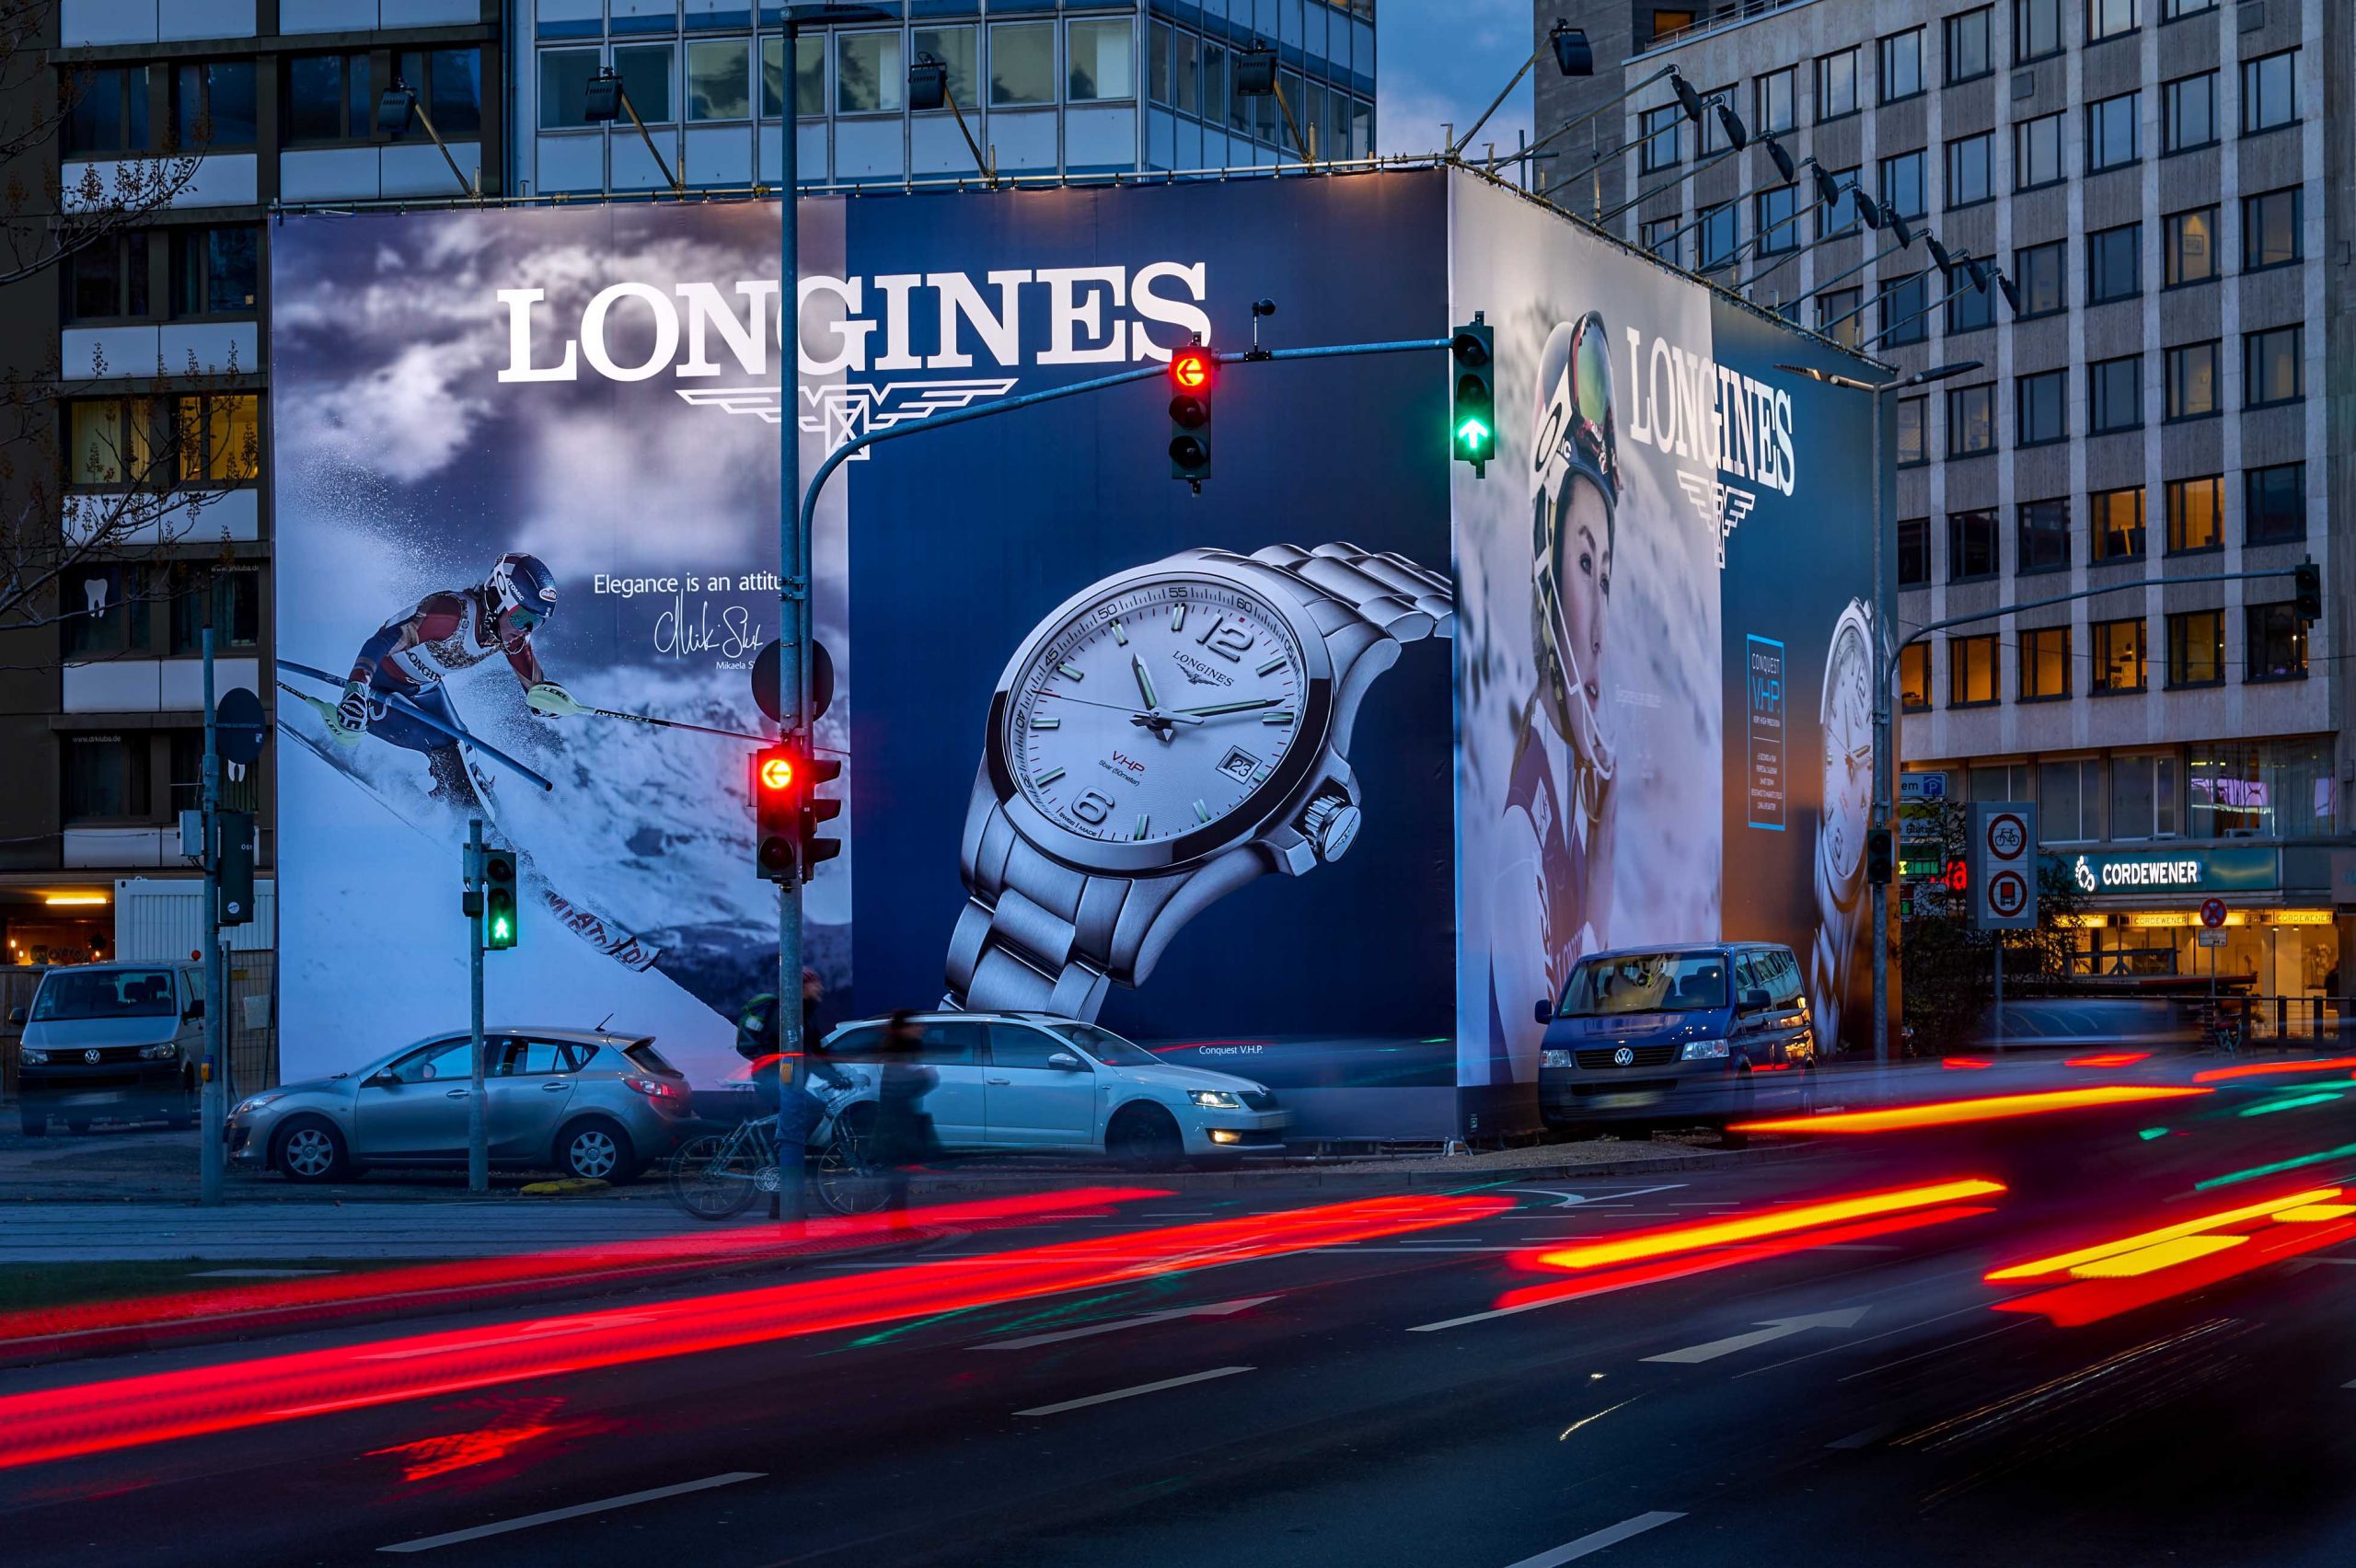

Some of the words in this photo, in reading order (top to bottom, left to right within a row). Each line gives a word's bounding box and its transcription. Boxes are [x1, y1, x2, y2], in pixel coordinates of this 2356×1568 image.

[497, 262, 1211, 383] LONGINES
[1627, 327, 1794, 496] LONGINES
[506, 577, 525, 602] ATOMIC
[595, 574, 678, 598] Elegance
[687, 572, 699, 592] is
[708, 576, 731, 592] an
[739, 571, 781, 591] attitu
[1169, 587, 1188, 598] 55
[1097, 604, 1118, 619] 50
[1236, 599, 1253, 613] 60
[1195, 613, 1254, 663] 12
[716, 661, 745, 670] Mikaela
[1045, 650, 1058, 667] 45
[1172, 651, 1235, 686] LONGINES
[1752, 652, 1781, 675] CONQUEST
[1015, 709, 1026, 729] 40
[1230, 757, 1253, 778] 23
[1900, 782, 1919, 790] em
[1070, 786, 1115, 825] 6
[2103, 861, 2200, 885] CORDEWENER
[1199, 1045, 1238, 1056] Conquest
[1240, 1044, 1264, 1054] V.H.P.
